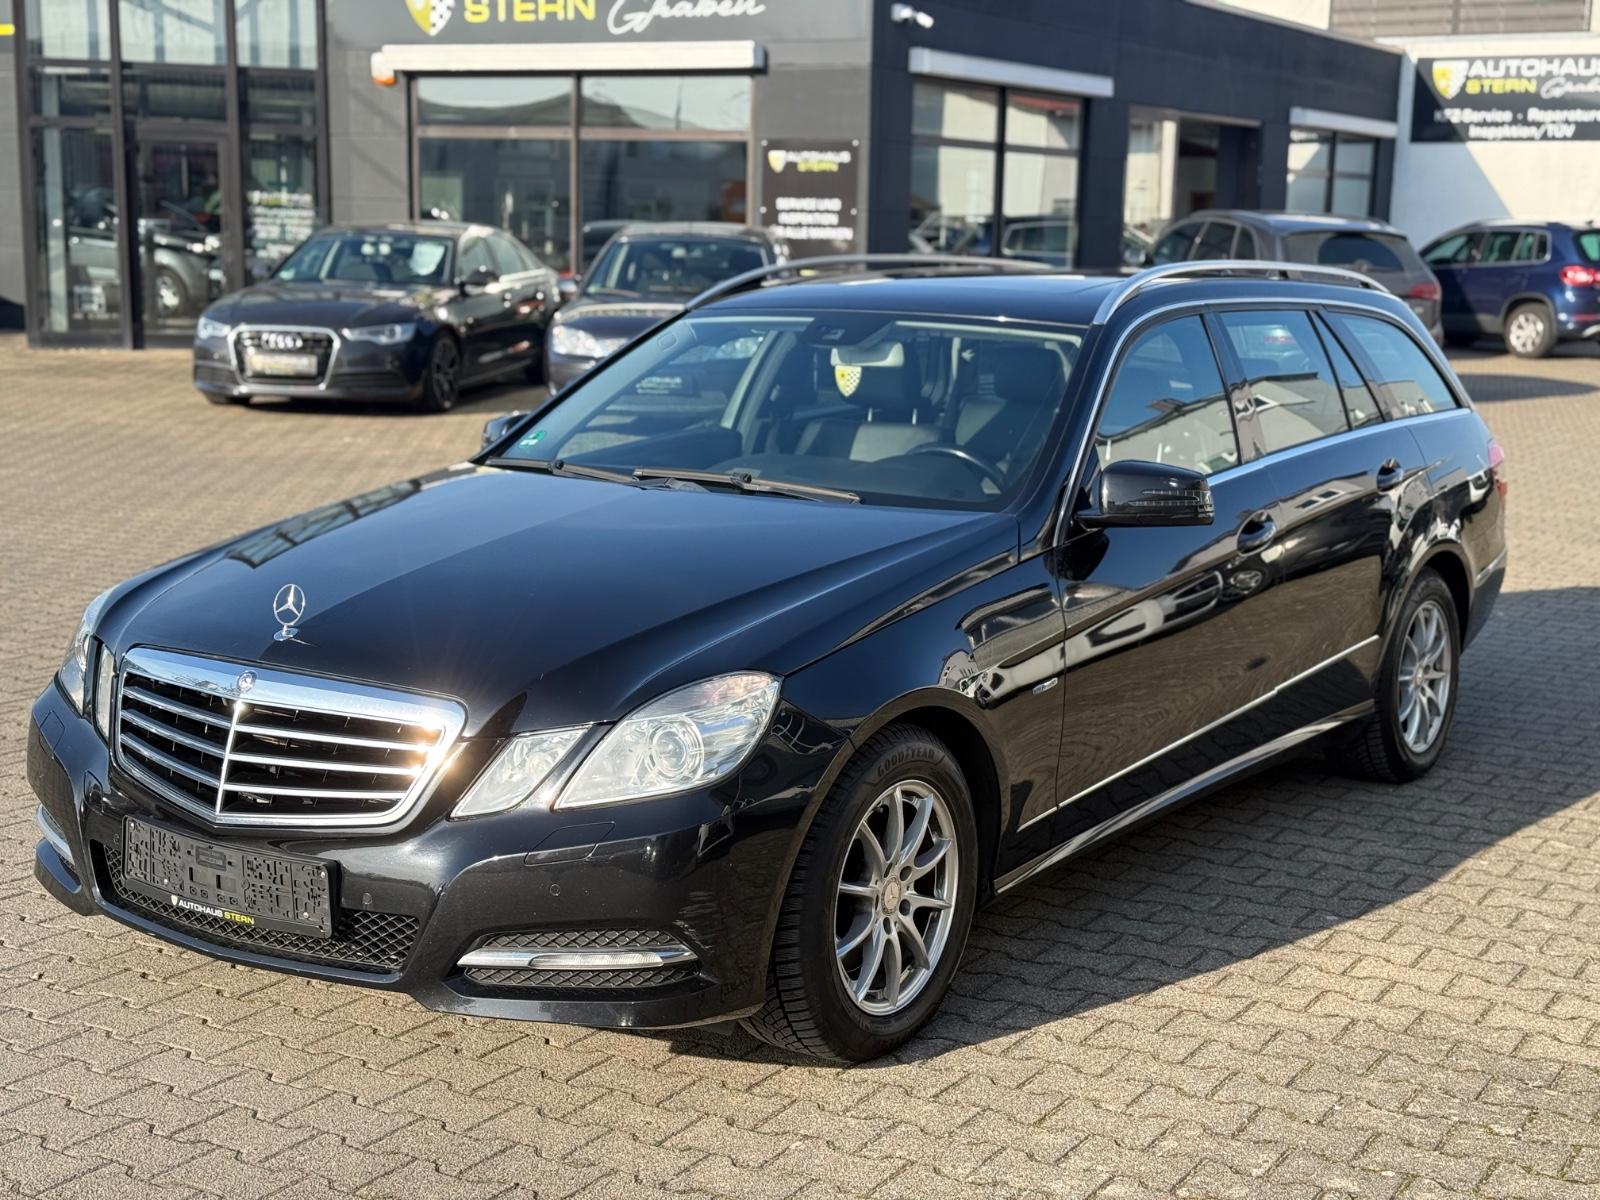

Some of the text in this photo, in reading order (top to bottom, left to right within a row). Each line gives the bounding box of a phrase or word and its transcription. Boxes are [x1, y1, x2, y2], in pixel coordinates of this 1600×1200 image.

[463, 0, 596, 24] STERN
[1465, 78, 1537, 95] STERN
[178, 899, 255, 925] AUTOHAUS STERN
